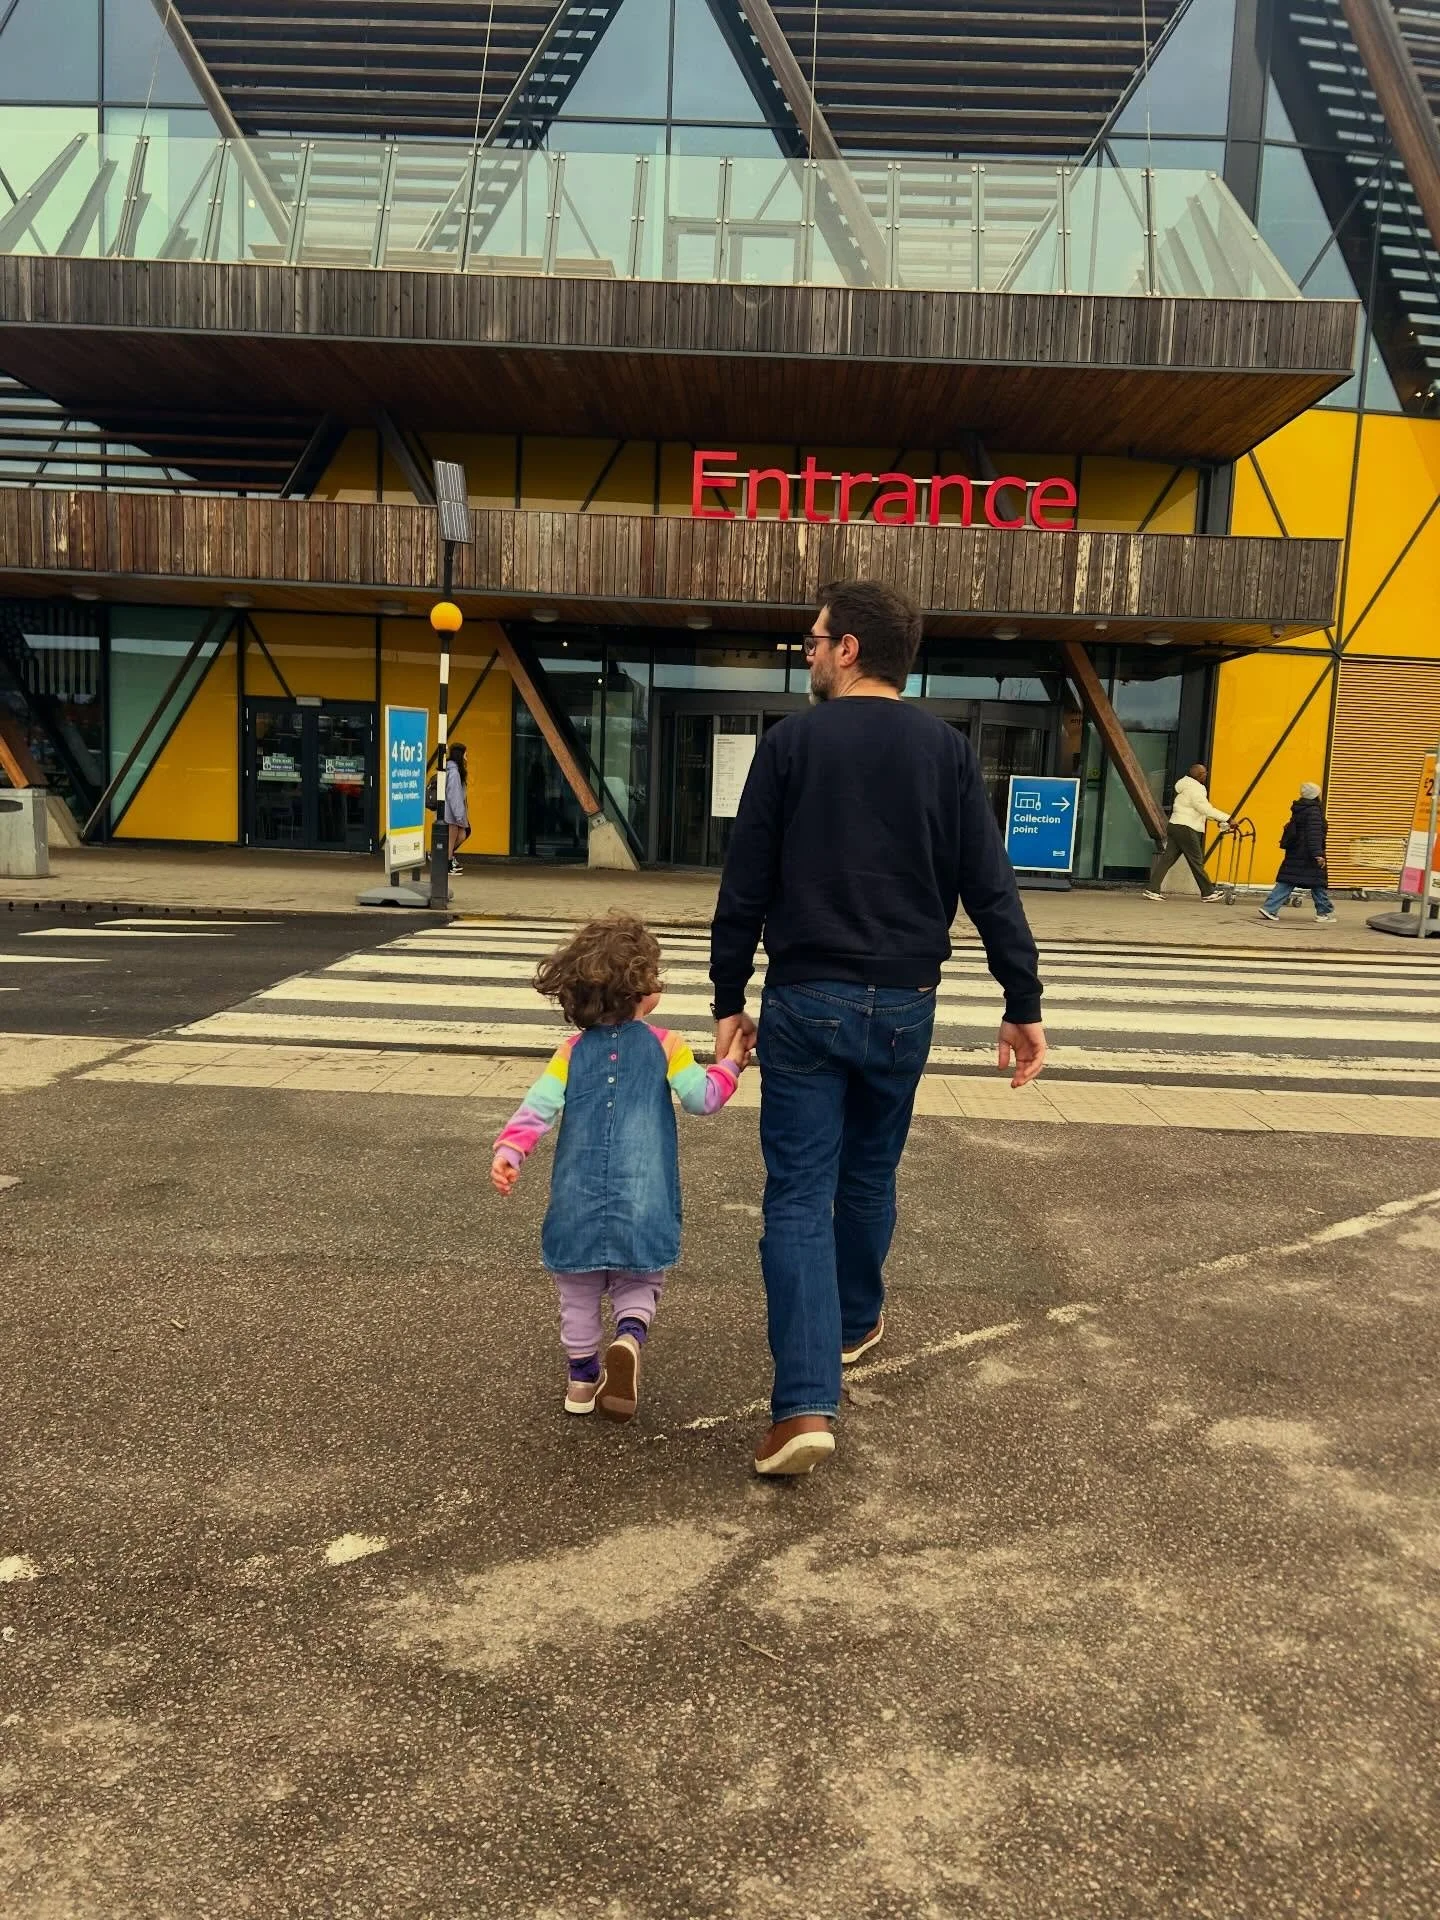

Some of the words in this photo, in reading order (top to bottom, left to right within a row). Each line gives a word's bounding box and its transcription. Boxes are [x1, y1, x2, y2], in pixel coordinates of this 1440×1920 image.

[692, 451, 1077, 529] Entrance
[392, 740, 398, 763] 4
[400, 739, 415, 763] for
[417, 741, 423, 762] 3
[1013, 813, 1061, 824] Collection
[1012, 825, 1039, 835] point
